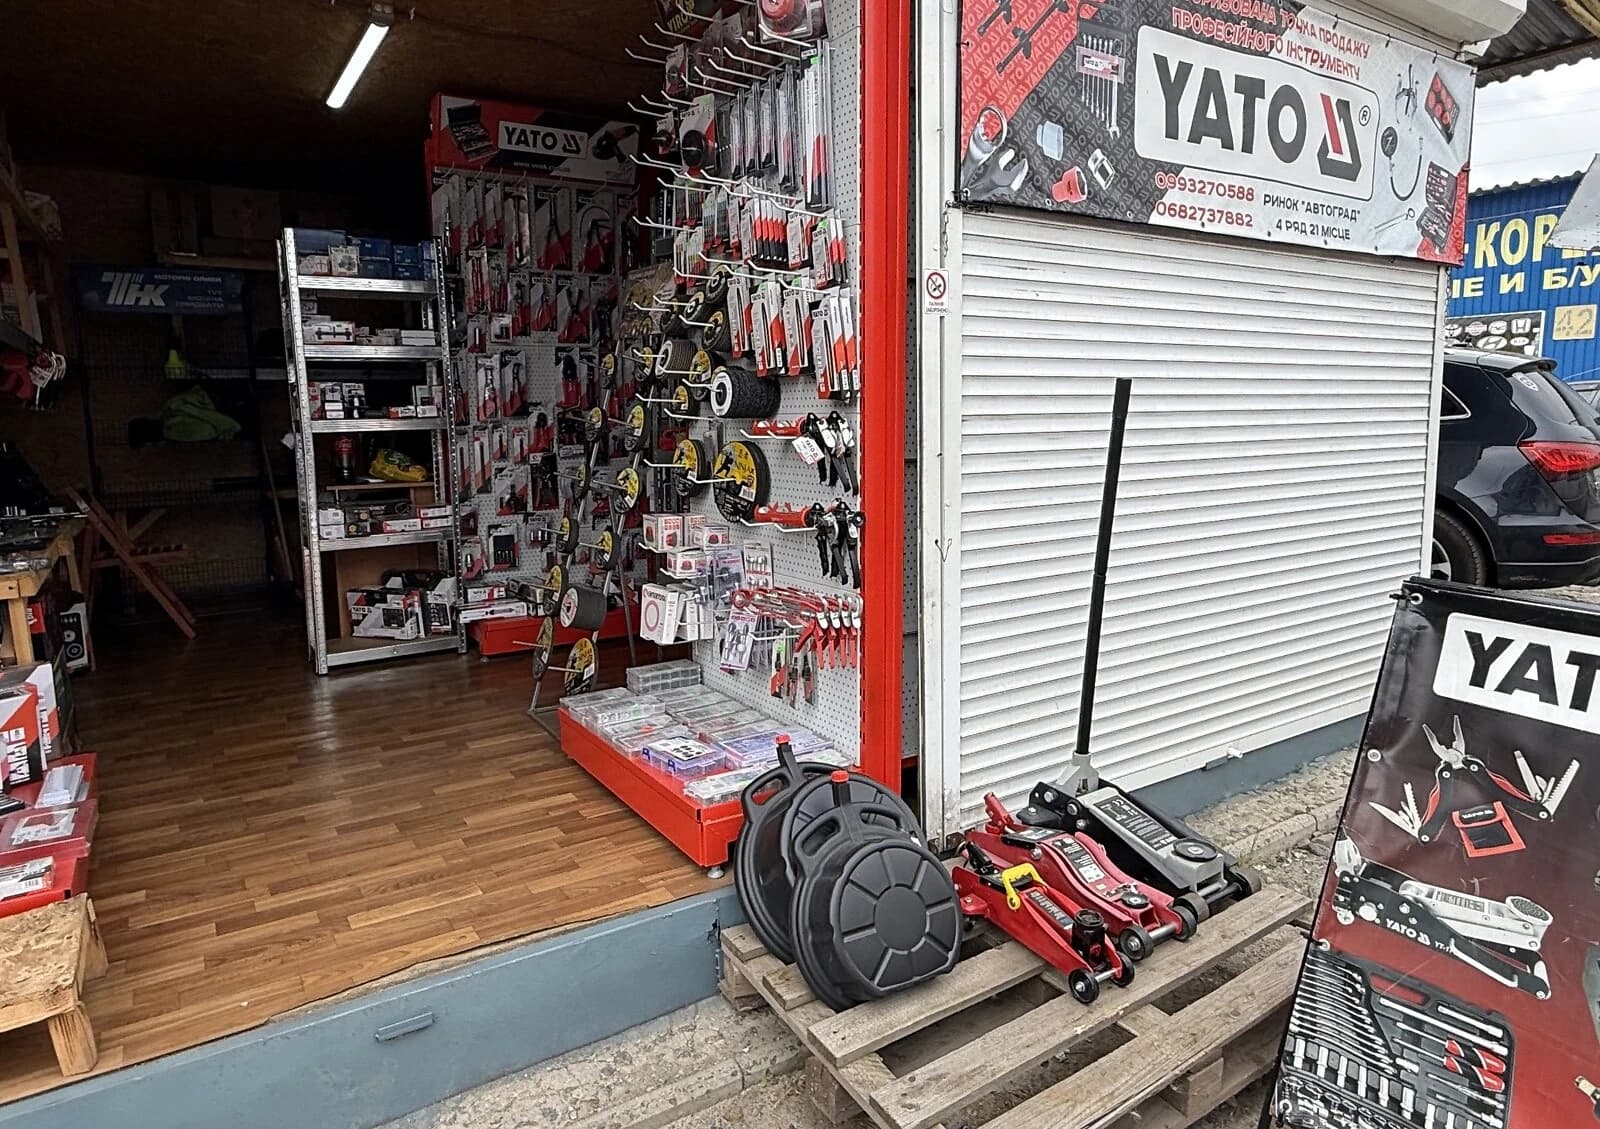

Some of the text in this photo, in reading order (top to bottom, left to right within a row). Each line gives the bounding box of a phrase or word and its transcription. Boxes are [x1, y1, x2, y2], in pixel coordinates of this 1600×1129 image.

[1172, 7, 1361, 80] ПРОФЕСІЙНОГО ІНСТРУМЕНТУ
[1280, 9, 1318, 39] ТОЧКА
[1319, 28, 1370, 59] ПРОДАЖУ
[1153, 52, 1307, 164] YATO
[504, 126, 558, 150] YATO
[1155, 171, 1255, 201] 0993270588
[1156, 201, 1253, 227] 0682737882
[1263, 193, 1361, 223] РИНОК "АВТОГРАД"
[1276, 221, 1350, 240] 4 РЯД 21 МІСЦЕ
[1464, 214, 1600, 269] -КОР
[1500, 272, 1525, 294] И
[1543, 263, 1600, 290] Б/У
[1464, 630, 1600, 713] YAT
[1385, 918, 1417, 938] YATO
